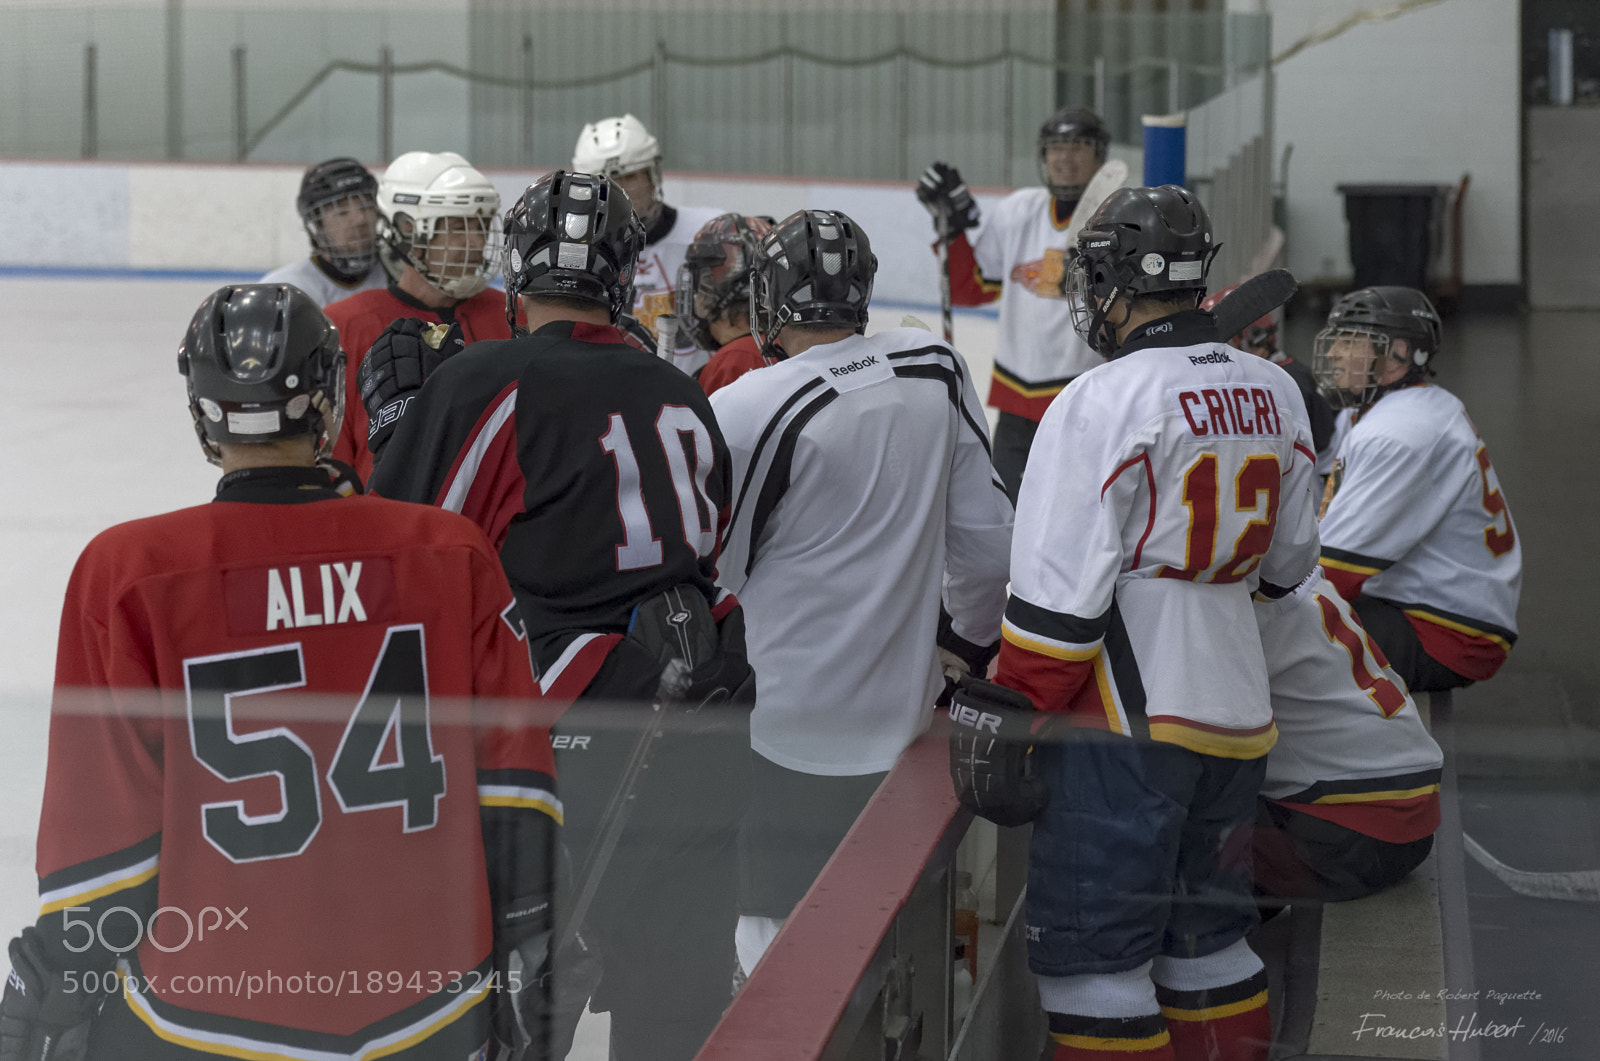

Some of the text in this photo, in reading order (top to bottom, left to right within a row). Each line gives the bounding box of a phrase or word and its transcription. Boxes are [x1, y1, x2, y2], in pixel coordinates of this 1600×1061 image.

[1090, 240, 1111, 248] BAUER
[1102, 286, 1119, 313] BAUER
[829, 354, 880, 378] Reebok
[1188, 350, 1234, 366] Reebok
[1178, 387, 1282, 437] CRICRI
[598, 403, 719, 573] 10
[1180, 452, 1282, 584] 12
[266, 560, 368, 632] ALIX
[182, 622, 448, 865] 54
[549, 734, 592, 750] ER
[505, 901, 549, 919] BAUER
